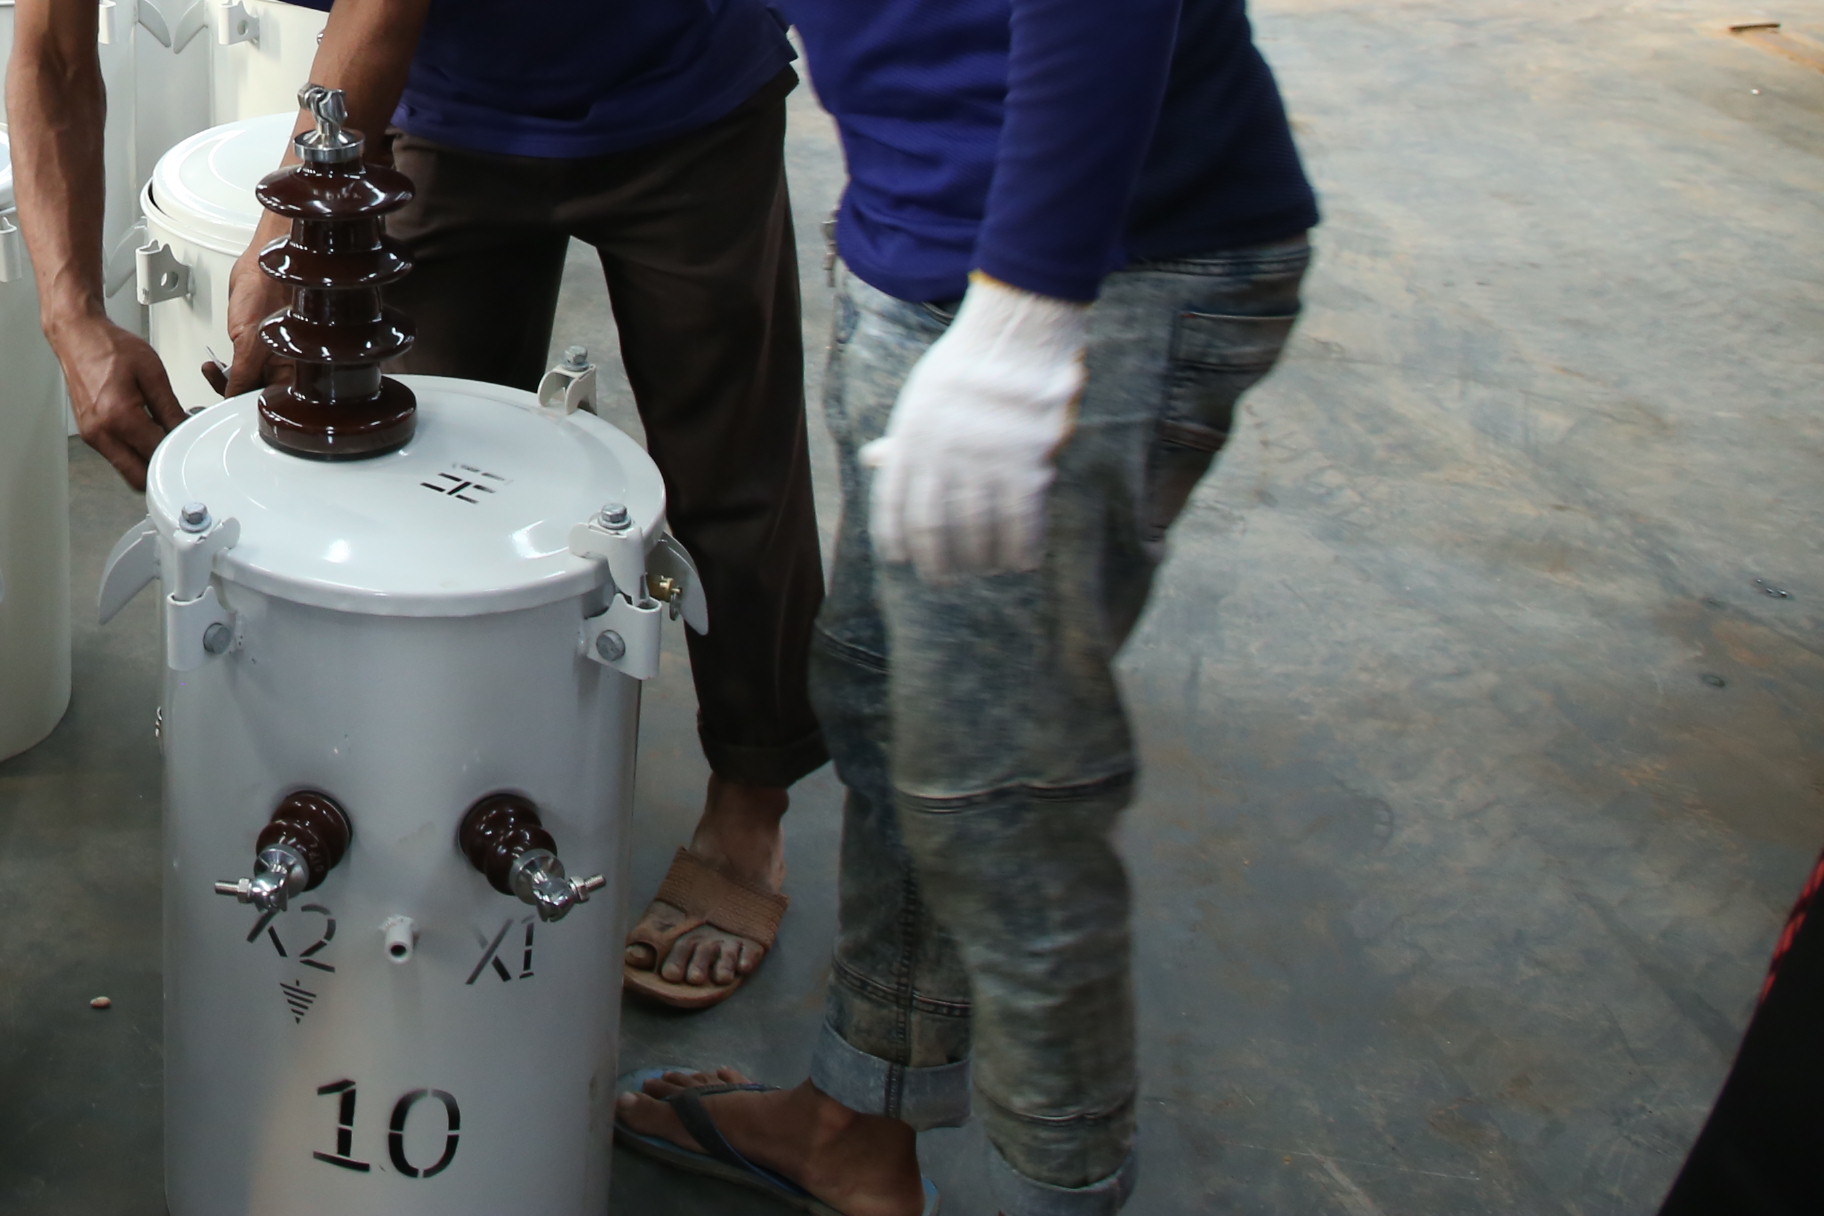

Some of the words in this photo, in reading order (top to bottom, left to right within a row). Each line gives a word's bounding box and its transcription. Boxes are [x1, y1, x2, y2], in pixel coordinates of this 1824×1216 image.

[246, 903, 337, 974] X2
[465, 914, 536, 985] X1
[312, 1078, 461, 1179] 10
